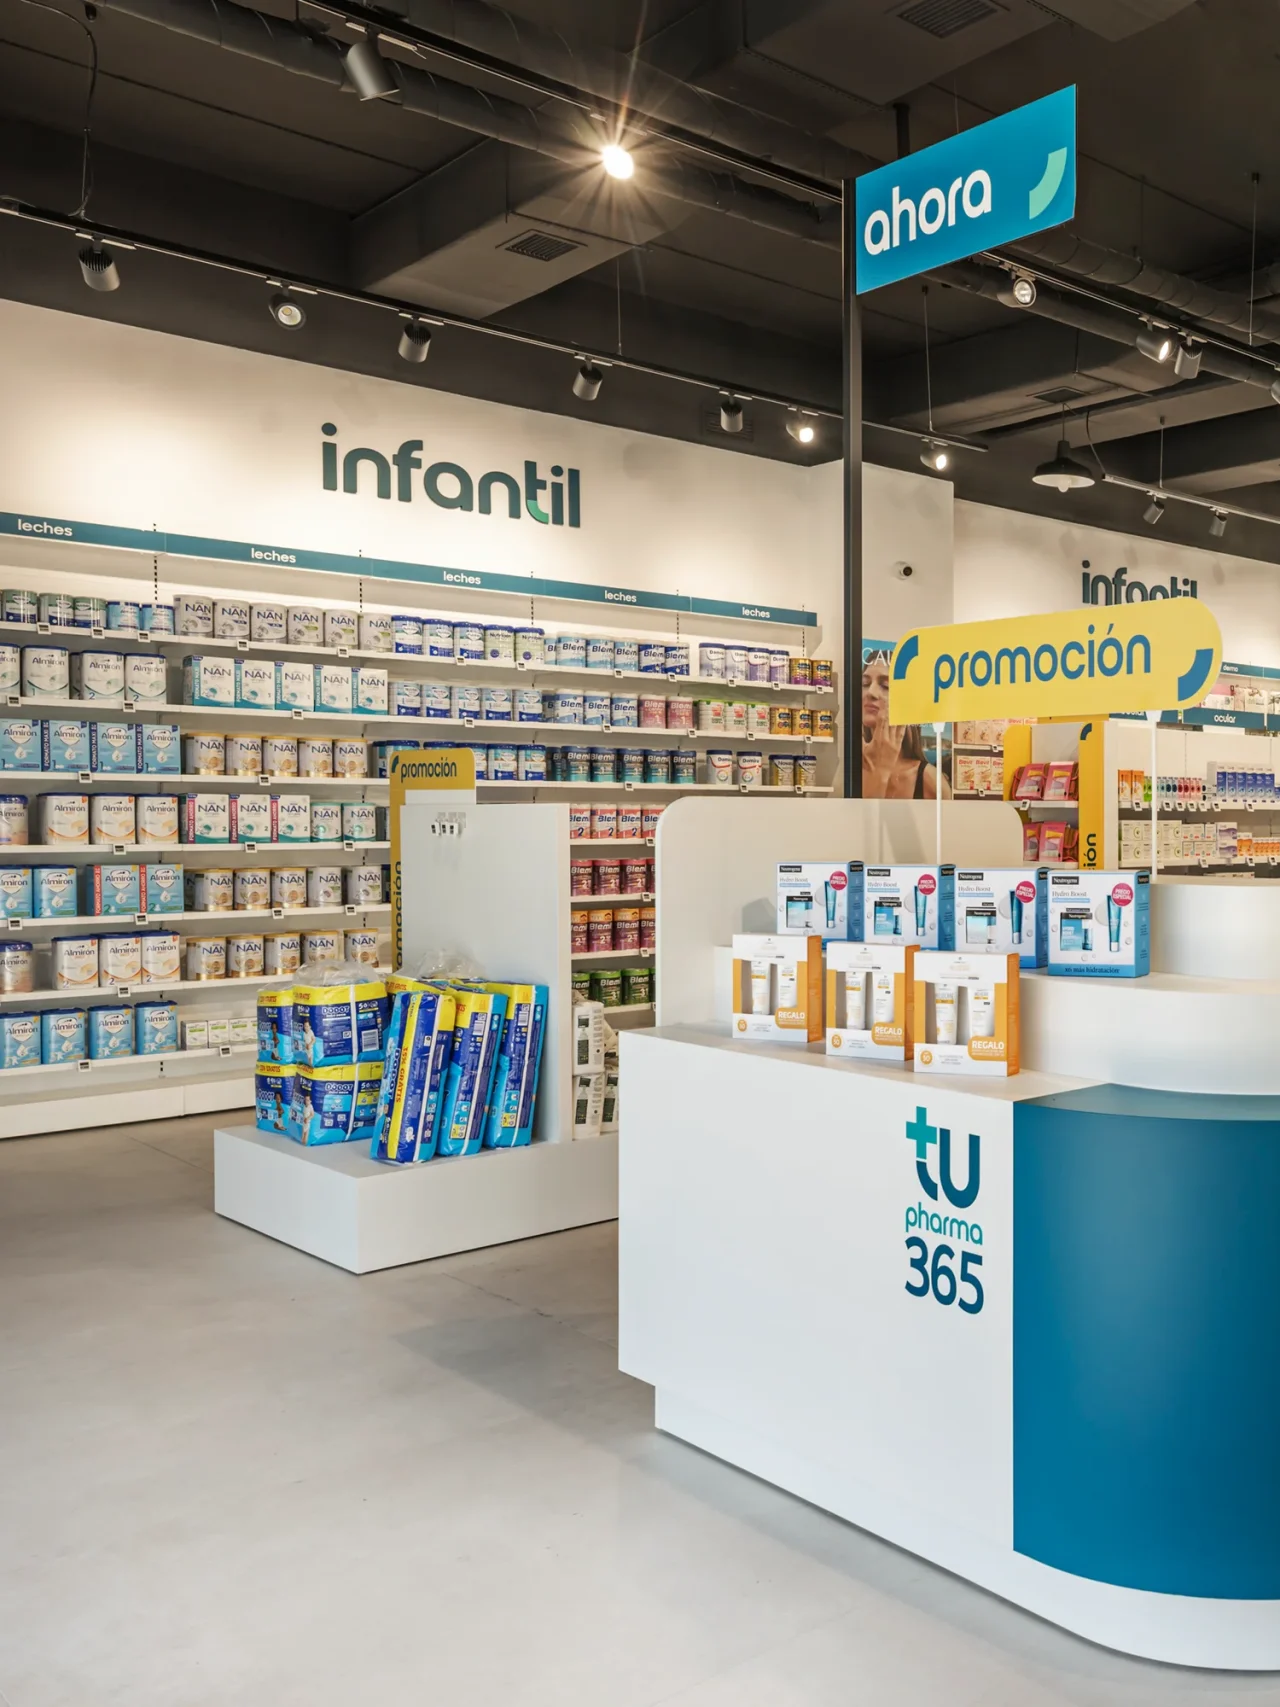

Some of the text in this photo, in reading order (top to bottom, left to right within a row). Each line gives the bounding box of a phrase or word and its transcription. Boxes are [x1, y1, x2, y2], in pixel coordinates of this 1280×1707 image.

[864, 169, 992, 256] ahora
[321, 422, 581, 528] infantil
[18, 518, 73, 537] leches
[251, 547, 297, 564] leches
[443, 571, 482, 585] leches
[604, 590, 637, 603] leches
[185, 603, 211, 613] NAN
[221, 607, 248, 617] NAN
[742, 606, 771, 619] leches
[257, 610, 283, 621] NAN
[293, 613, 319, 623] NAN
[331, 616, 355, 626] NAN
[369, 619, 391, 629] NAN
[934, 623, 1151, 704] promoción
[203, 667, 232, 676] NAN
[244, 670, 272, 679] NAN
[284, 671, 311, 682] NAN
[323, 674, 350, 685] NAN
[360, 677, 385, 687] NAN
[1214, 713, 1237, 724] ocular
[200, 741, 225, 750] NAN
[239, 742, 261, 751] NAN
[274, 743, 297, 753] NAN
[312, 745, 332, 754] NAN
[339, 746, 364, 755] NAN
[401, 756, 457, 783] promoción
[198, 804, 226, 813] NAN
[240, 804, 268, 813] NAN
[280, 804, 307, 814] NAN
[351, 809, 375, 818] NAN
[314, 810, 339, 819] NAN
[210, 878, 233, 886] NAN
[958, 885, 976, 893] Hydro
[1052, 890, 1071, 898] Hydro
[778, 1011, 805, 1020] REGALO
[875, 1026, 902, 1036] REGALO
[972, 1040, 1005, 1050] REGALO
[325, 1083, 353, 1091] DODOT
[395, 1067, 405, 1103] GRATIS
[906, 1105, 981, 1209] tu
[905, 1201, 983, 1246] pharma
[905, 1236, 985, 1315] 365
